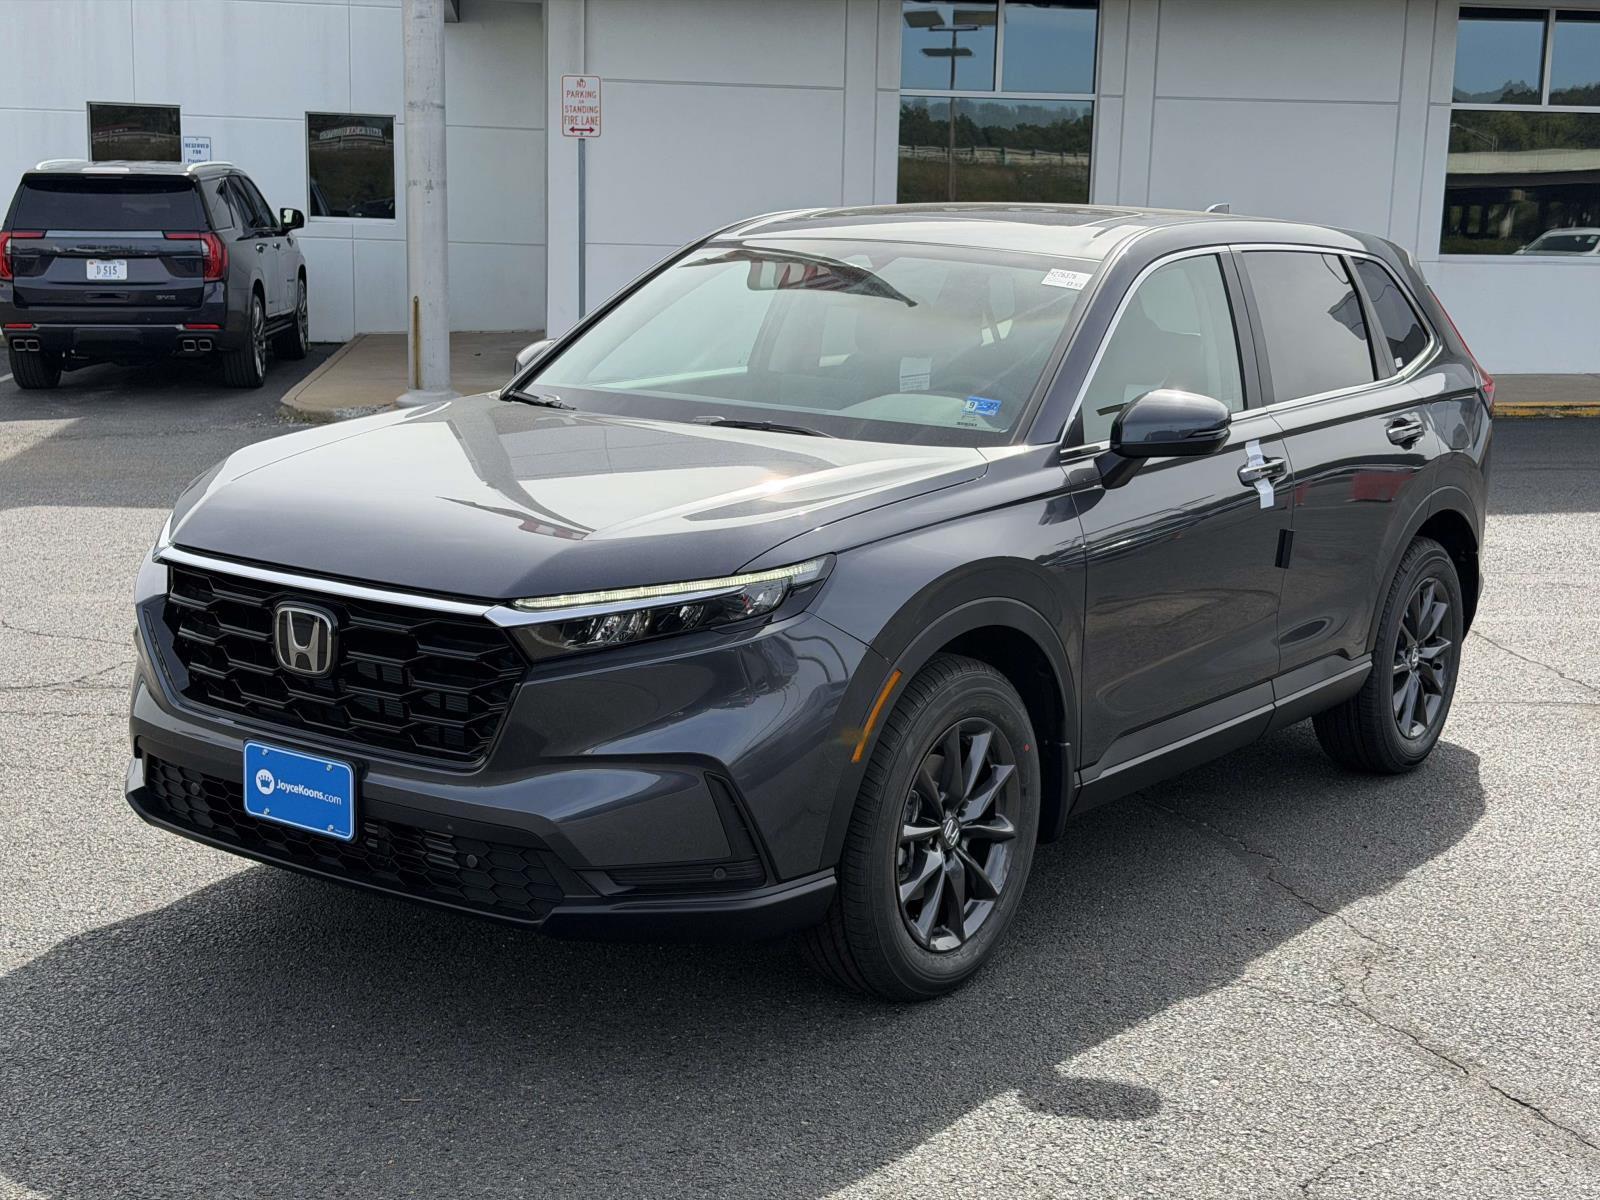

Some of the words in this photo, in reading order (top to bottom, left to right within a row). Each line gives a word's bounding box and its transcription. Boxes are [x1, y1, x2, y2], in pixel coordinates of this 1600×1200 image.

[576, 79, 587, 89] NO
[566, 90, 597, 99] PARKING
[564, 105, 599, 114] STANDING
[564, 115, 579, 126] FIRE
[581, 115, 600, 127] LANE
[103, 264, 118, 275] 515
[276, 779, 342, 806] JoyceKoons.com
